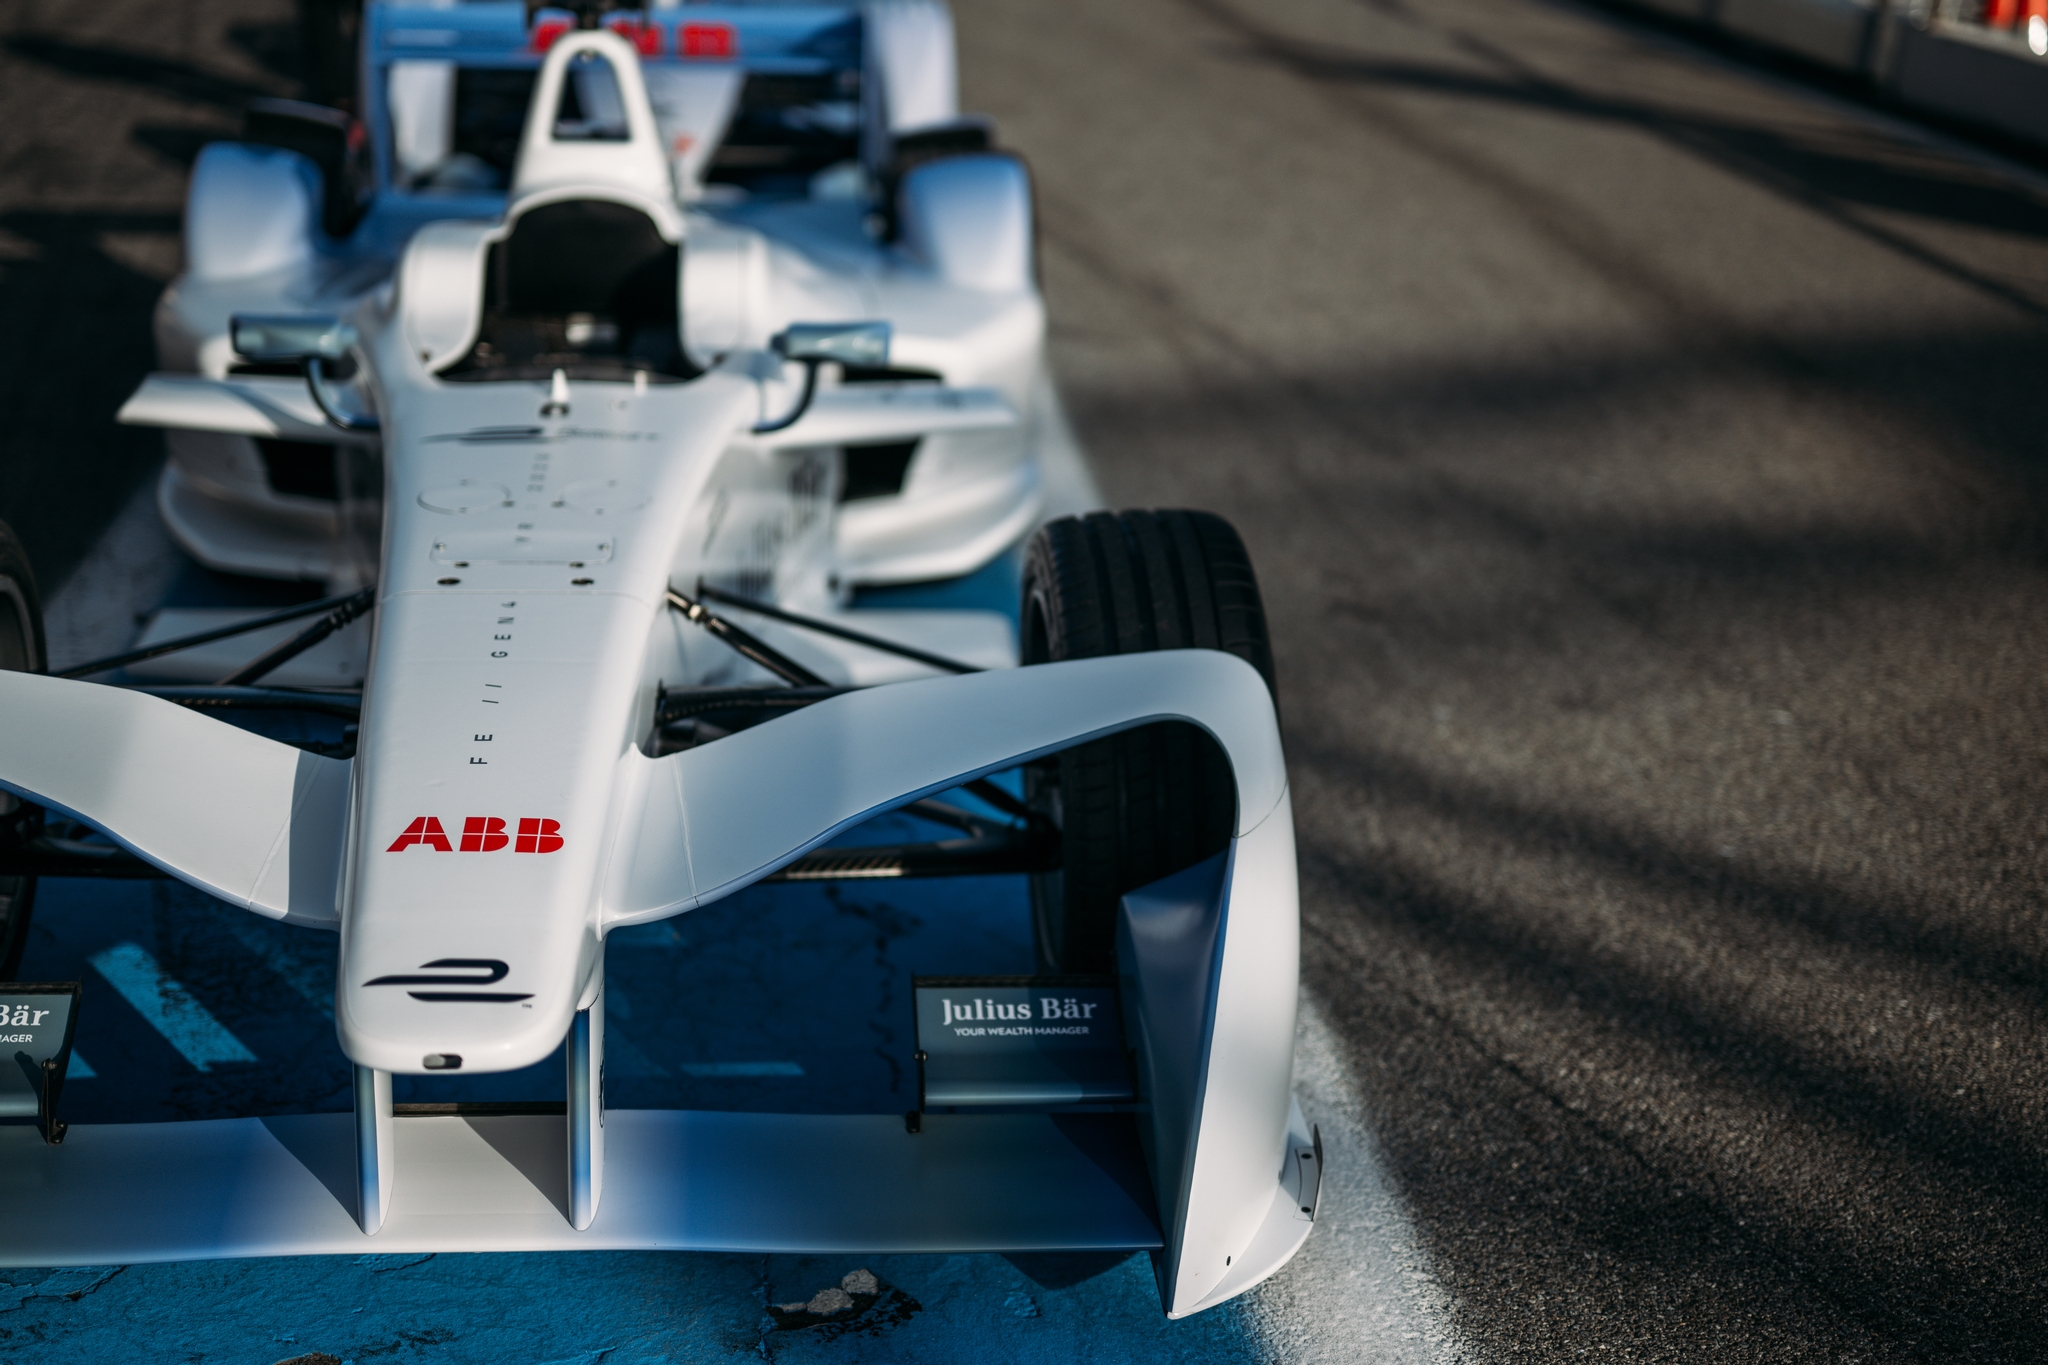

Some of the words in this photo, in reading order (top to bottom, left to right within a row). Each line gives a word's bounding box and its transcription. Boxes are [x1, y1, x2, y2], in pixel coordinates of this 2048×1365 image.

[469, 732, 493, 765] FE
[385, 816, 565, 854] ABB
[942, 998, 1032, 1026] Julius
[1040, 997, 1098, 1020] Bär
[954, 1027, 986, 1037] YOUR
[986, 1026, 1033, 1036] WEALTH
[1034, 1026, 1090, 1035] MANAGER
